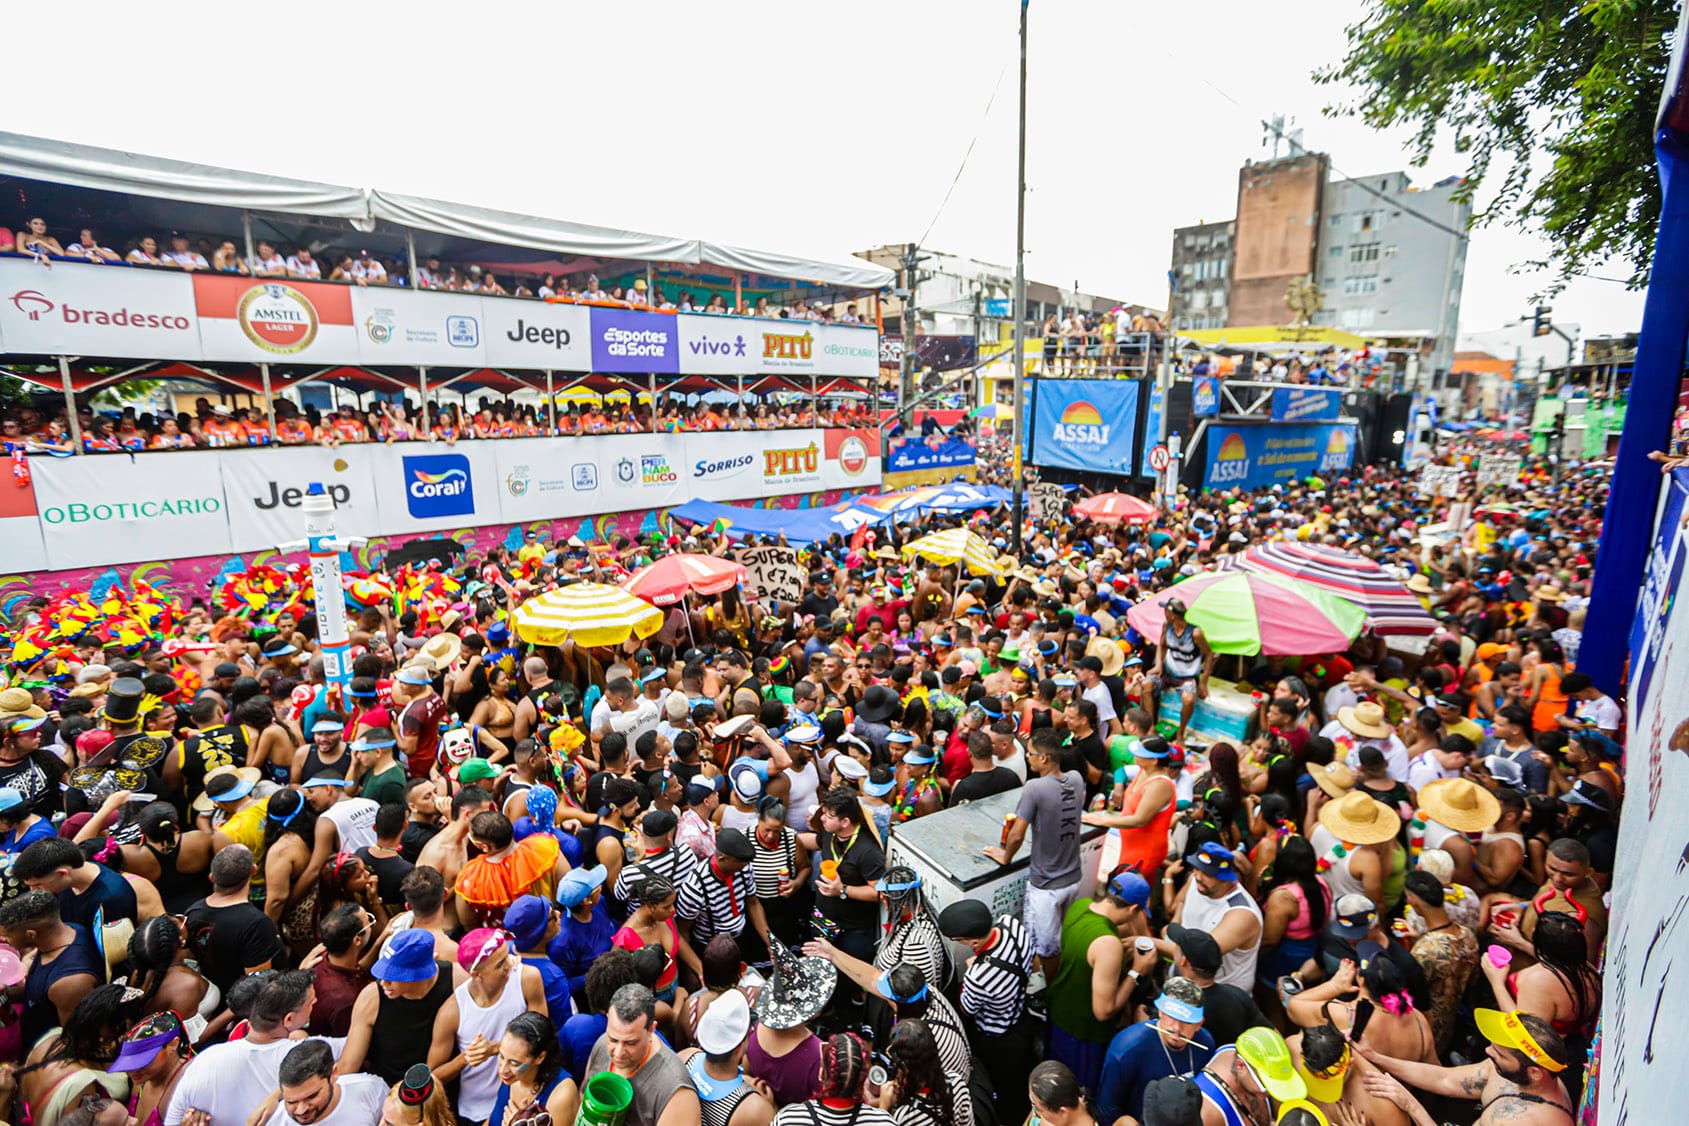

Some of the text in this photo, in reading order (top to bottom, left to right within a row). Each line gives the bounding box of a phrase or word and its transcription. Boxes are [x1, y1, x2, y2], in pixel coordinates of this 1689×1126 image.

[62, 304, 190, 330] bradesco
[254, 308, 303, 321] AMSTEL
[264, 323, 295, 332] LAGER
[506, 319, 571, 350] Jeep
[603, 326, 668, 345] Esportes
[626, 342, 665, 357] Sorte
[689, 336, 730, 356] vivo
[762, 330, 815, 359] PITÚ
[763, 441, 819, 475] PITÚ
[410, 480, 461, 498] Coral
[642, 472, 677, 483] BUCO
[254, 481, 350, 511] Jep
[742, 548, 798, 568] SUPER
[315, 584, 329, 636] LIDEYE
[1060, 789, 1076, 842] NIKE
[1613, 922, 1629, 1103] JOHNNIE
